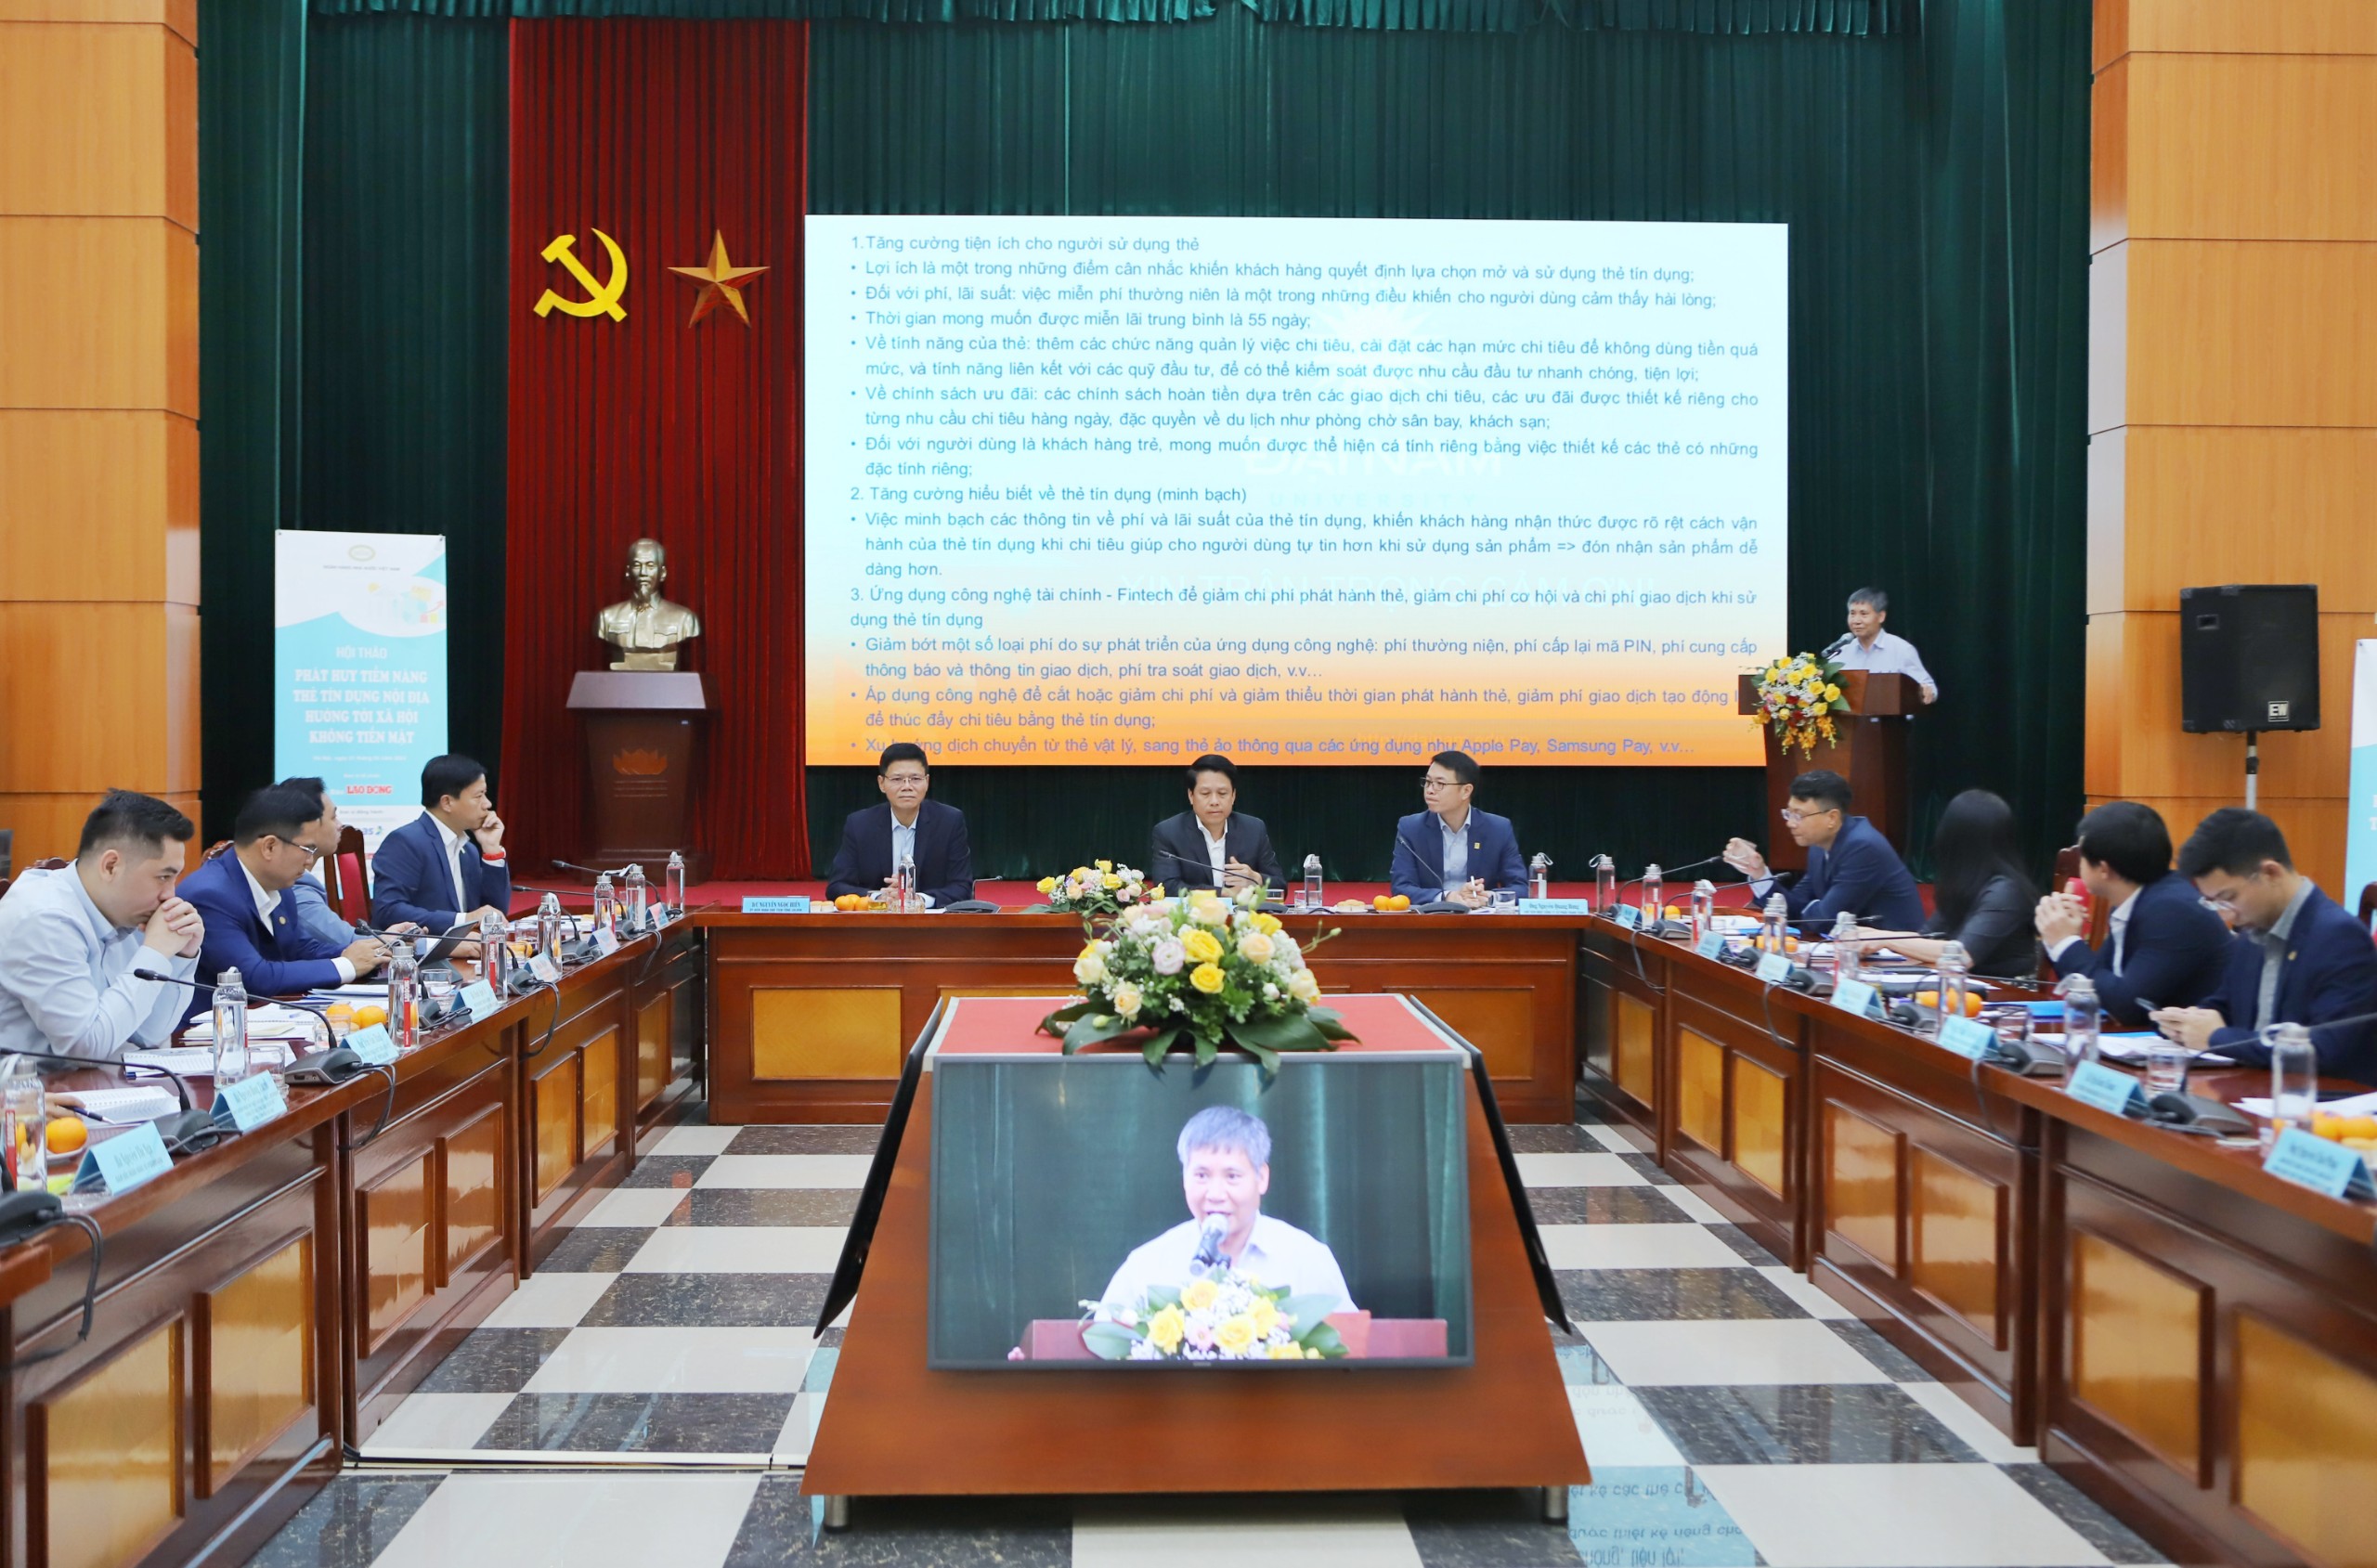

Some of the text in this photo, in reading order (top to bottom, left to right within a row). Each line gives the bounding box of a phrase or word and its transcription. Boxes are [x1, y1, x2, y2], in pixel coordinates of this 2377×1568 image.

[909, 236, 959, 253] cường
[965, 236, 991, 252] tiện
[998, 236, 1020, 250] ích
[1025, 237, 1053, 250] cho
[1058, 237, 1102, 253] người
[1109, 237, 1128, 251] sử
[1133, 238, 1170, 253] dụng
[1176, 237, 1200, 251] thẻ
[865, 259, 1694, 284] Lợi ích là một trong những điểm cân nhắc khiến khách hàng quyết định lựa chọn mở và sử dụng thẻ tín dụng;
[865, 308, 1310, 330] Thời gian mong muốn được miễn lãi trung bình là 55 ngày;
[865, 461, 972, 479] đặc tính riêng;
[851, 484, 1247, 504] 2. Tăng cường hiểu biết về thẻ tín dụng (minh bạch)
[865, 563, 942, 579] dàng hơn.
[851, 612, 983, 629] dụng thẻ tín dụng
[865, 663, 906, 680] thông
[914, 663, 941, 677] báo
[946, 663, 964, 677] và
[969, 663, 1011, 680] thông
[1018, 663, 1035, 676] tin
[1040, 663, 1072, 680] giao
[1077, 663, 1112, 679] dịch,
[1119, 663, 1141, 680] phí
[1147, 664, 1167, 677] tra
[1173, 663, 1203, 677] soát
[1209, 664, 1240, 680] giao
[1246, 663, 1280, 679] dịch,
[865, 710, 1155, 730] để thúc đẩy chi tiêu bằng thẻ tín dụng;
[947, 738, 978, 754] dịch
[984, 735, 1036, 755] chuyển
[1044, 738, 1059, 752] từ
[1065, 738, 1088, 752] thẻ
[1094, 738, 1115, 754] vật
[1144, 741, 1179, 756] sang
[1185, 737, 1209, 752] thẻ
[1214, 737, 1232, 751] ảo
[1238, 738, 1279, 755] thông
[1285, 741, 1313, 755] qua
[1318, 738, 1344, 752] các
[1349, 738, 1380, 756] ứng
[1384, 738, 1422, 756] dụng
[1462, 739, 1504, 755] Apple
[1510, 738, 1539, 756] Pay,
[1547, 738, 1617, 756] Samsung
[1623, 738, 1653, 756] Pay,
